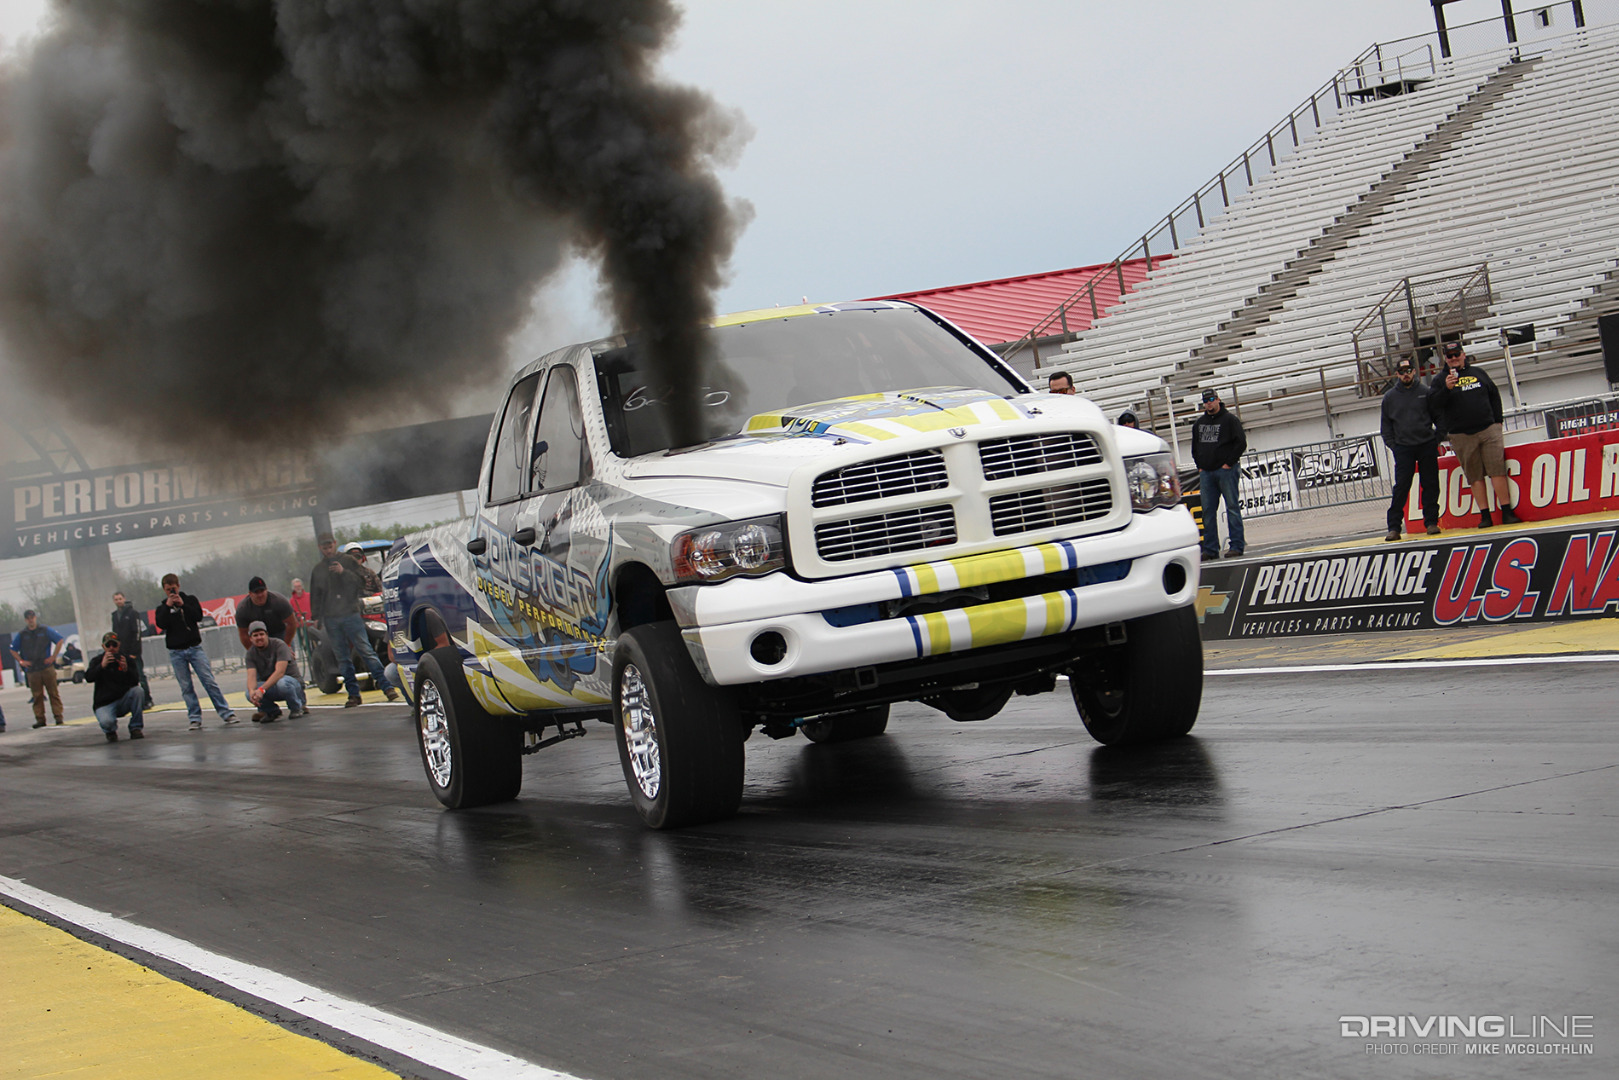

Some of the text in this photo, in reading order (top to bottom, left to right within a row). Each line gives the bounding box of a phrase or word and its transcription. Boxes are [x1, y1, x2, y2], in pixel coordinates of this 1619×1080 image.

[1538, 9, 1549, 26] 1
[1560, 417, 1587, 430] HIGH
[1297, 440, 1374, 479] SOTA
[1530, 448, 1590, 508] OIL
[18, 495, 318, 547] VEHICLES PARTS RACING
[478, 577, 513, 606] DIESEL
[1249, 550, 1438, 606] PERFORMANCE
[1433, 537, 1540, 625] U.S.
[1242, 611, 1421, 636] VEHICLES PARTS RACING
